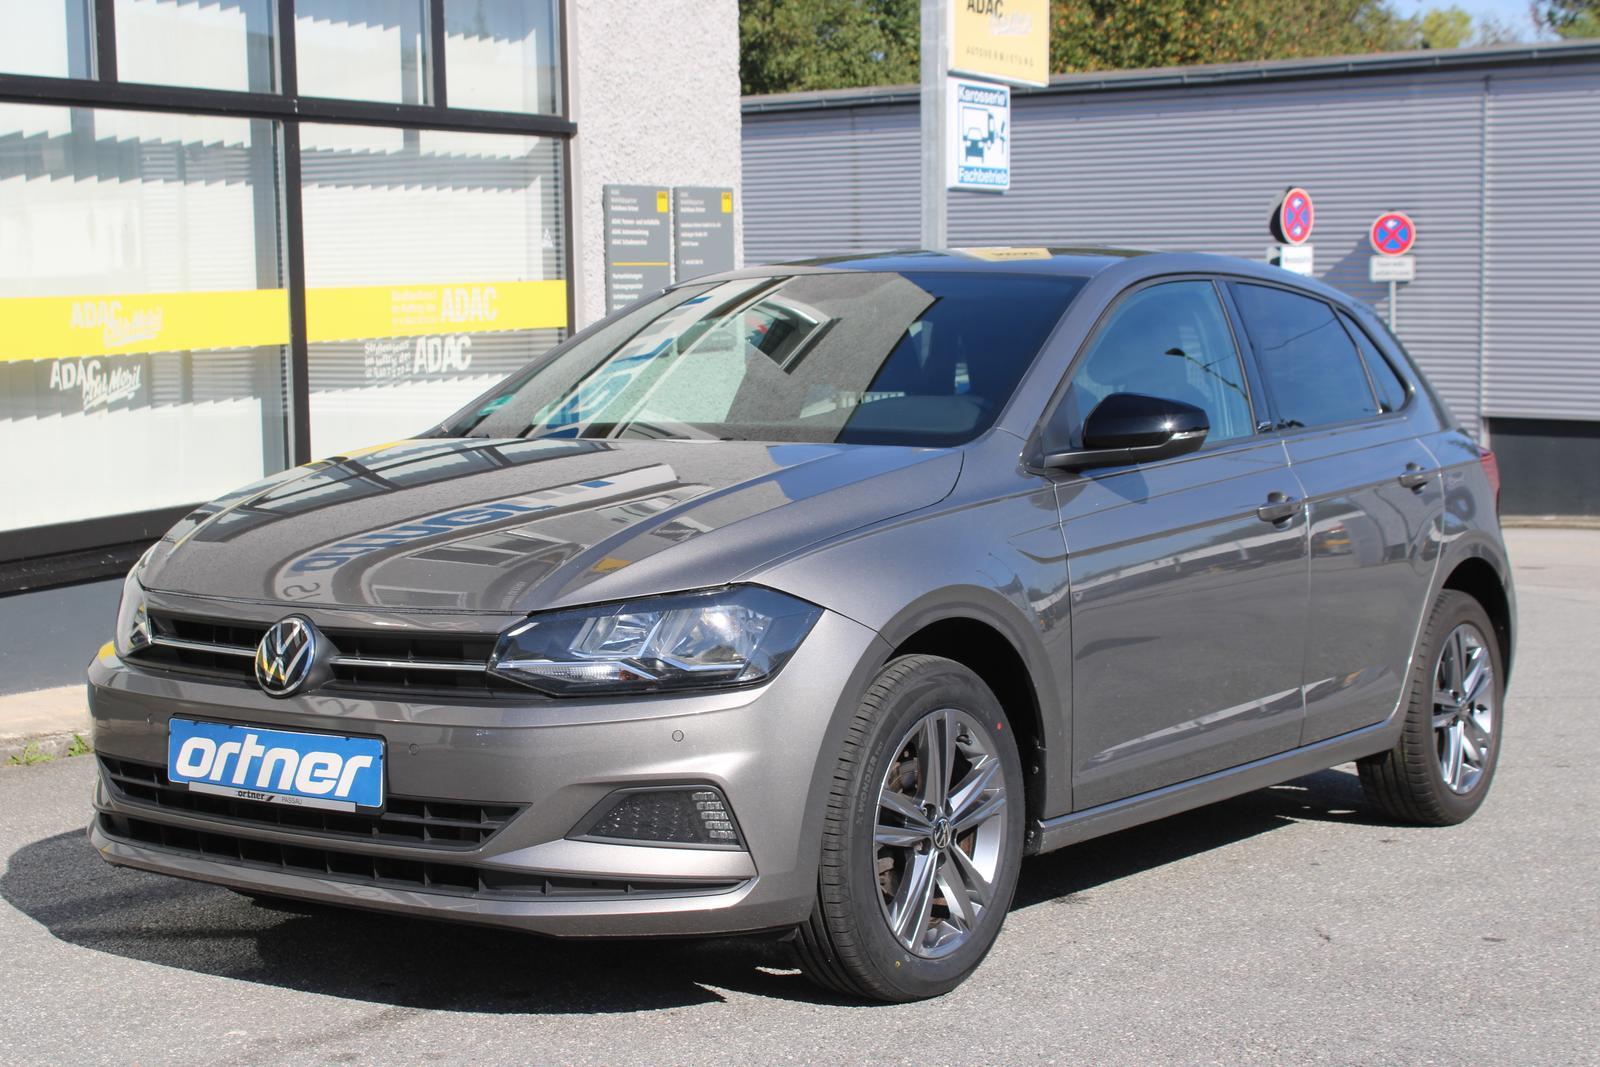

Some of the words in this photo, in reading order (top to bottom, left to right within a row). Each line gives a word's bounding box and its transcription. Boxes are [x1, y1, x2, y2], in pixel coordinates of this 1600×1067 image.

[959, 86, 1006, 107] Karosserie
[959, 167, 1007, 185] Fachbetrieb
[70, 300, 122, 330] ADAC
[441, 287, 497, 323] ADAC
[414, 335, 473, 374] ADAC
[50, 359, 101, 391] ADAC
[175, 733, 374, 797] ortner
[237, 789, 266, 800] ortner
